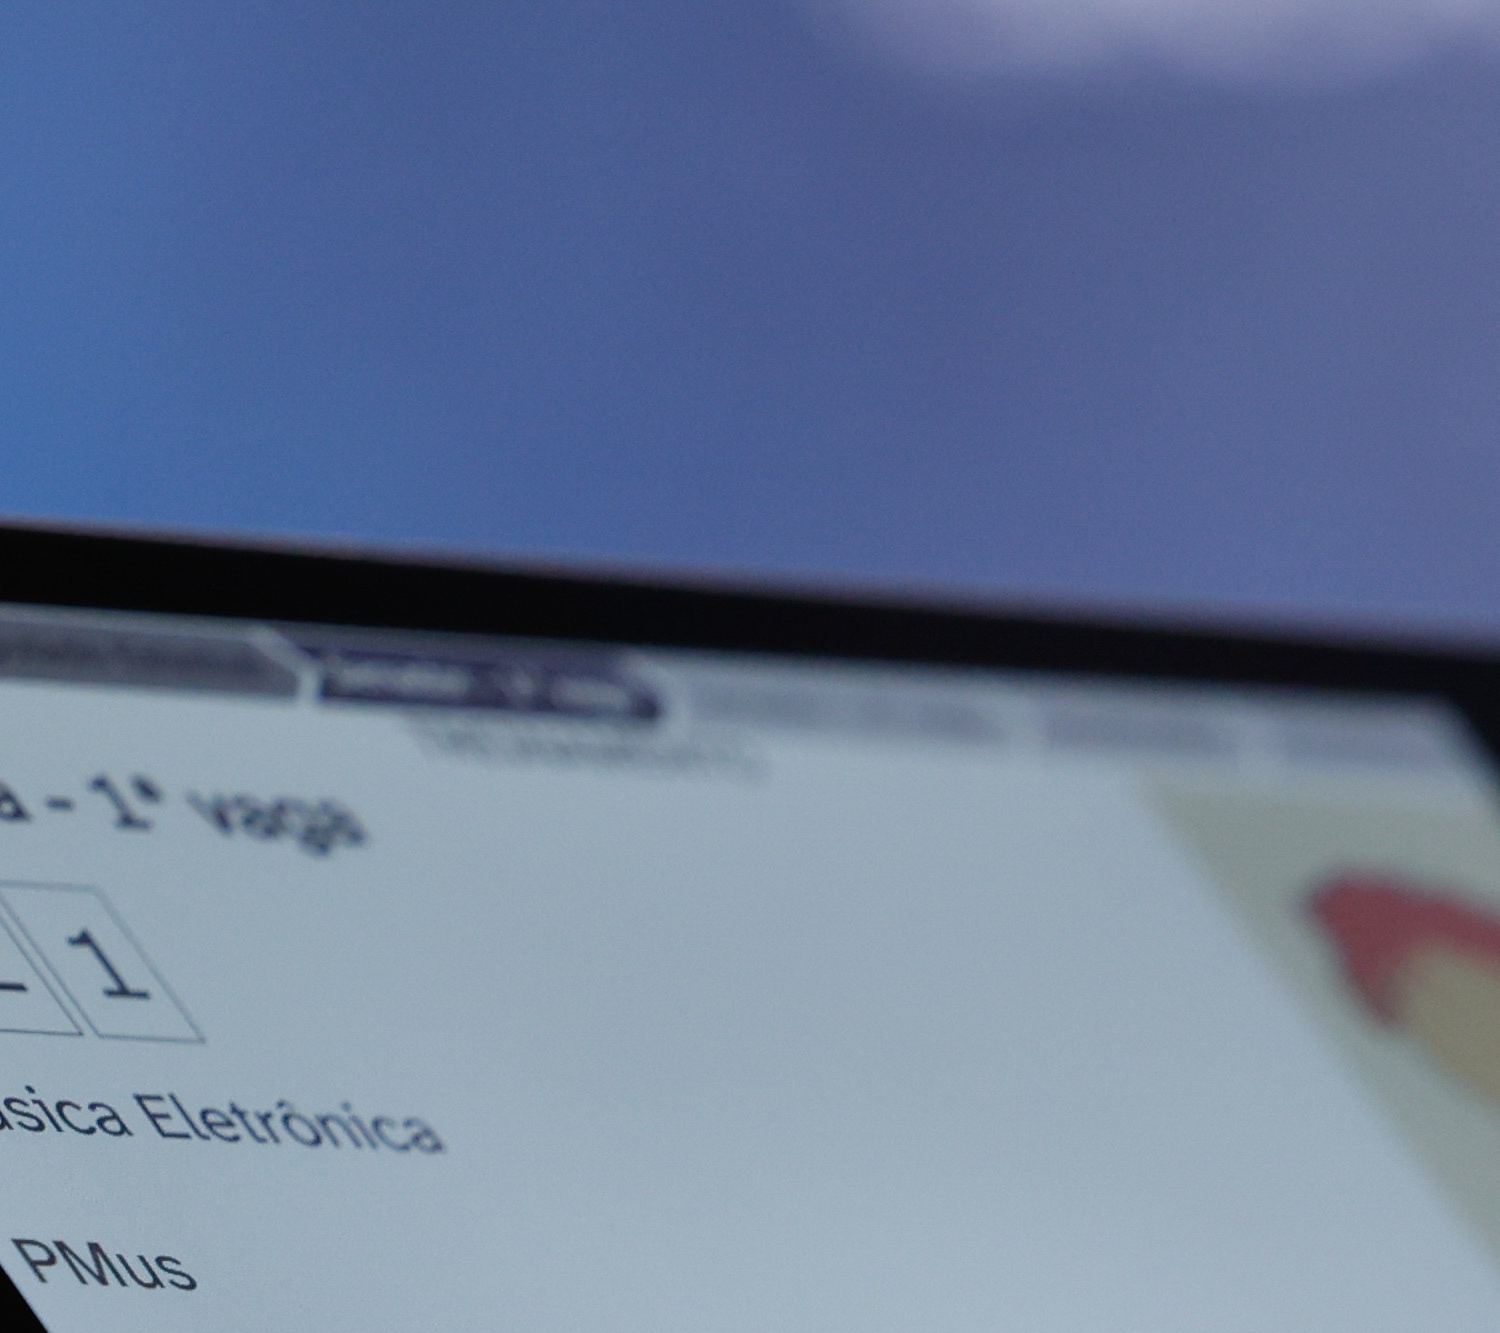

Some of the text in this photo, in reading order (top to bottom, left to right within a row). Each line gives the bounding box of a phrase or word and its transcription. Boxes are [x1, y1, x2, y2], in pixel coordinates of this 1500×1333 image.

[184, 786, 366, 856] vaga
[136, 1093, 446, 1155] Eletrônica
[14, 1238, 199, 1292] PMus
